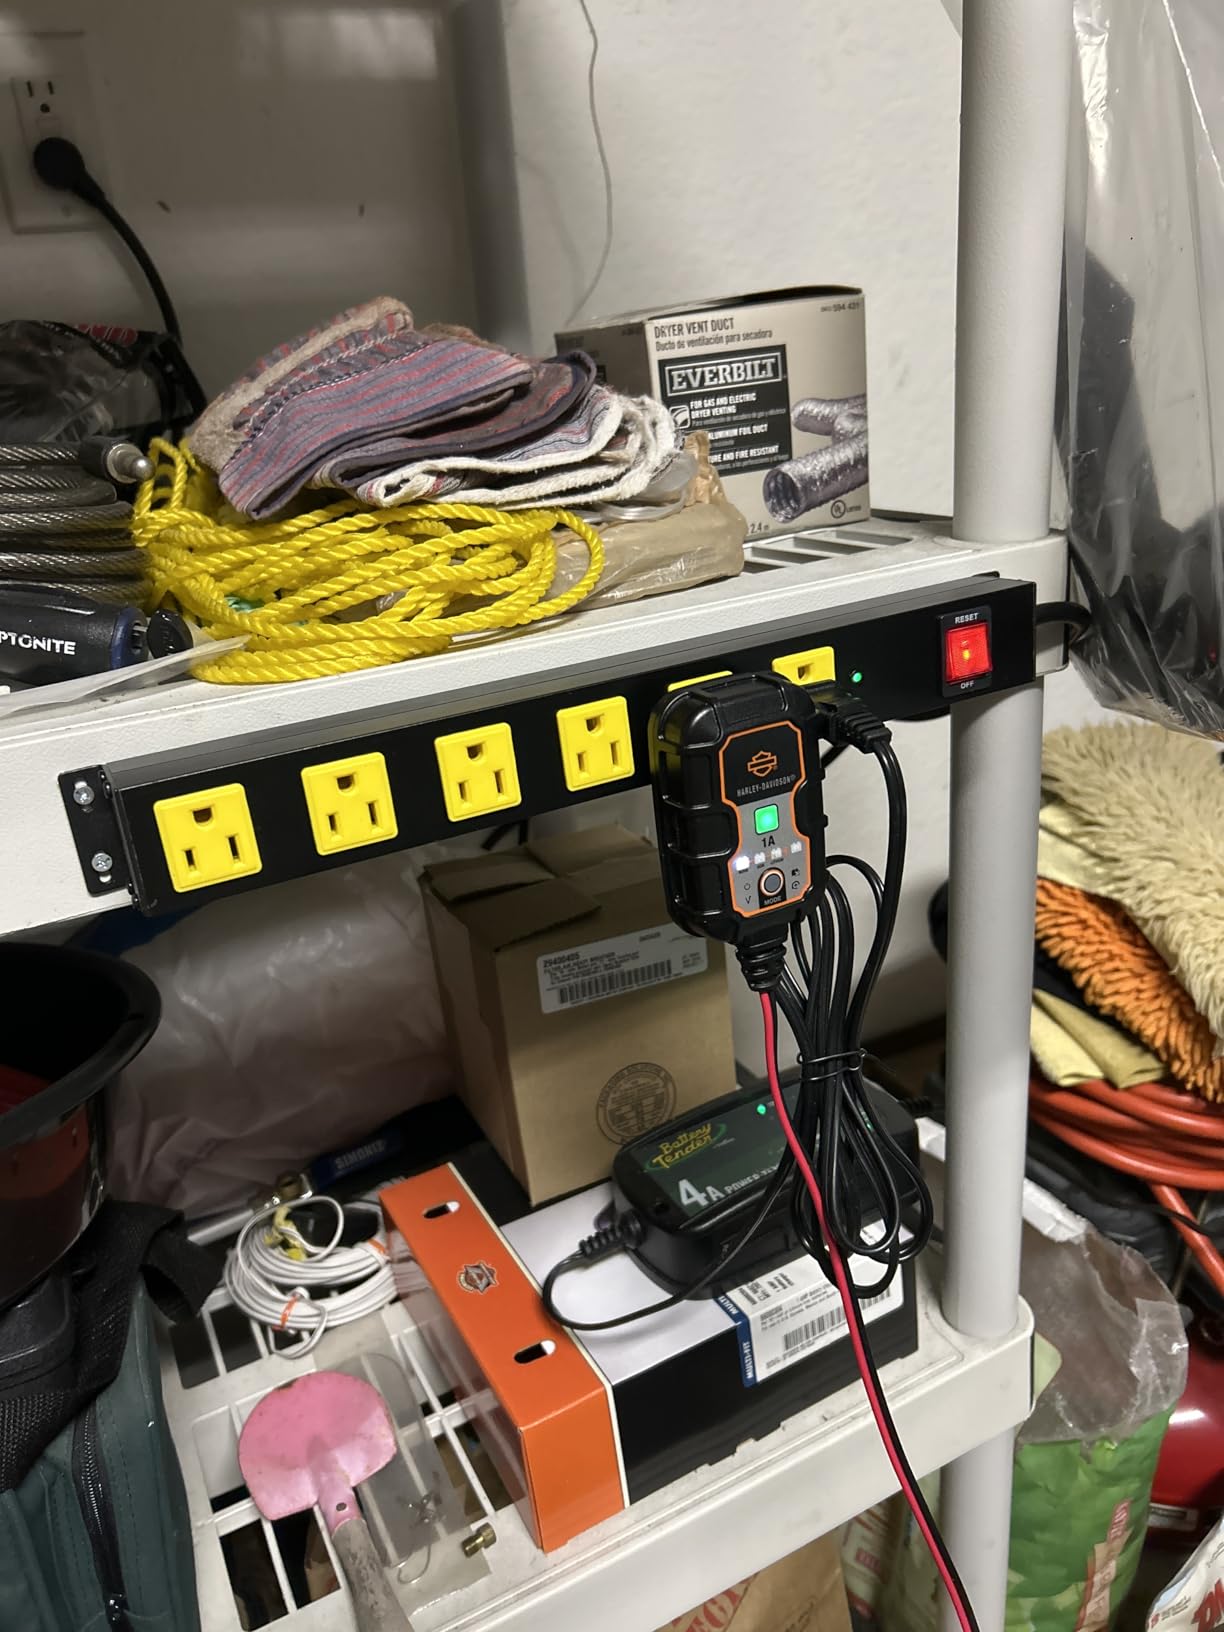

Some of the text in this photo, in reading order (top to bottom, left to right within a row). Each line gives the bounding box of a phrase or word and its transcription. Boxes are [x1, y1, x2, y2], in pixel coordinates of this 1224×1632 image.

[654, 317, 734, 339] DRYER VENT DUCT
[656, 328, 773, 352] Ducto de ventilación para secadora
[671, 358, 776, 391] EVERBILT
[690, 392, 756, 409] FOR GAS AND ELECTRIC
[691, 409, 711, 419] DRYER
[711, 405, 737, 416] VENTING
[739, 426, 752, 436] FOIL
[752, 423, 768, 434] DUCT
[723, 452, 735, 461] AND
[735, 449, 749, 459] FIRE
[749, 445, 779, 457] RESISTANT
[955, 612, 979, 624] RESET
[0, 631, 76, 656] PTONITE
[961, 680, 974, 690] OFF
[761, 835, 776, 848] 1A
[764, 896, 783, 905] MODE
[659, 1123, 712, 1154] Battery
[652, 1134, 713, 1169] Tender
